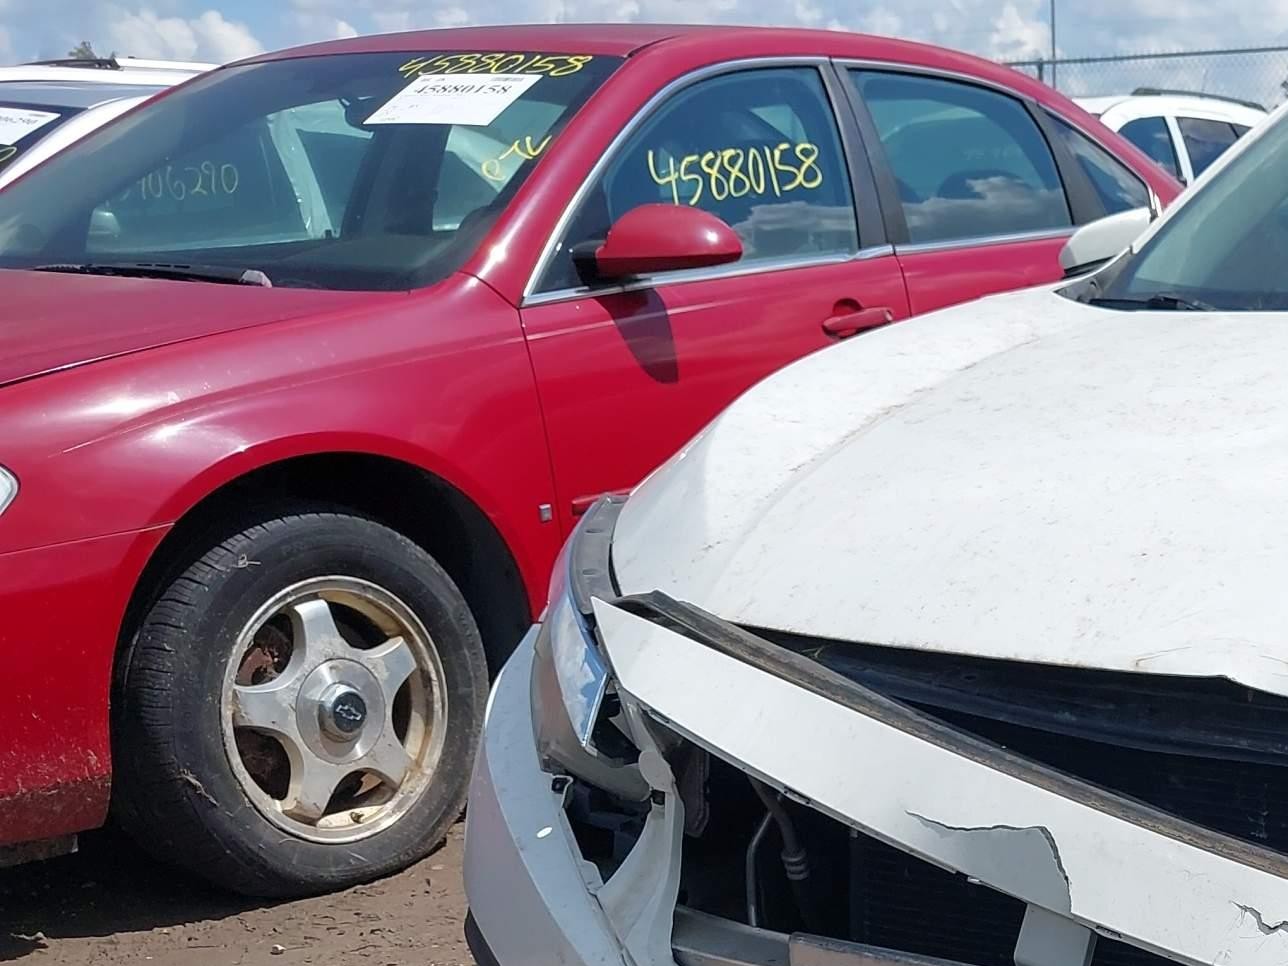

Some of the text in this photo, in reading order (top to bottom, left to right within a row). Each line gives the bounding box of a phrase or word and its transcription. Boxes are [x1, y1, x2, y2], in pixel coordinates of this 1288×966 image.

[399, 53, 593, 78] 45880158
[413, 84, 513, 95] 45880158
[648, 143, 822, 206] 45880158
